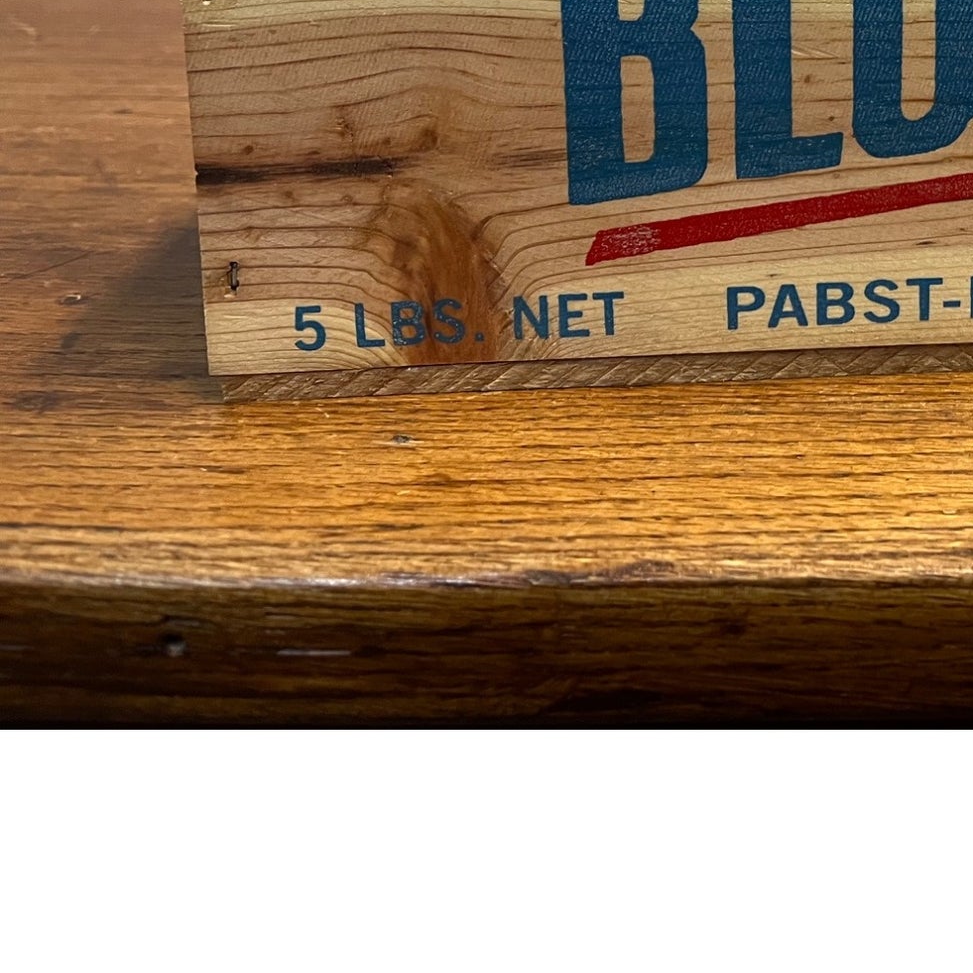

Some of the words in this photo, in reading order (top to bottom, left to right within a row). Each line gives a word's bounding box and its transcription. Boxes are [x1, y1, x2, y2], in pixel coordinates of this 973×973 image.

[294, 305, 328, 352] 5
[354, 299, 485, 349] LBS.
[513, 291, 625, 340] NET
